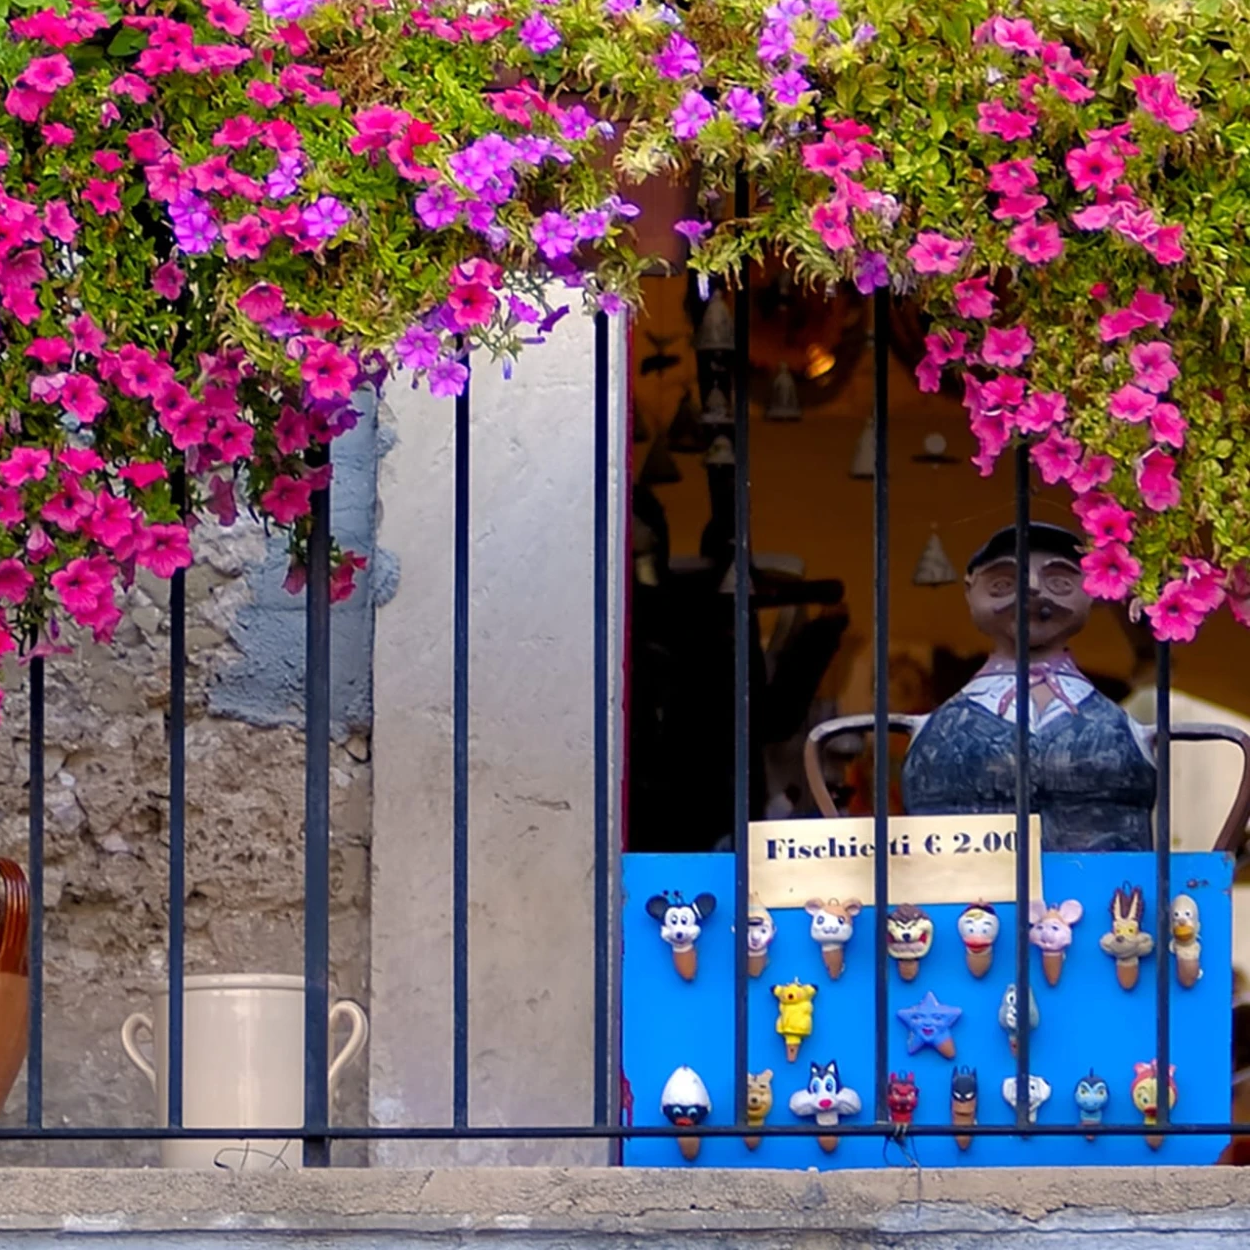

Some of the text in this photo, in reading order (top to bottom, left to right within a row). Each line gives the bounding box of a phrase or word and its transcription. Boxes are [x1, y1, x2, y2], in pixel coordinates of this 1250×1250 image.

[766, 831, 1018, 859] Fischieti € 2.00
